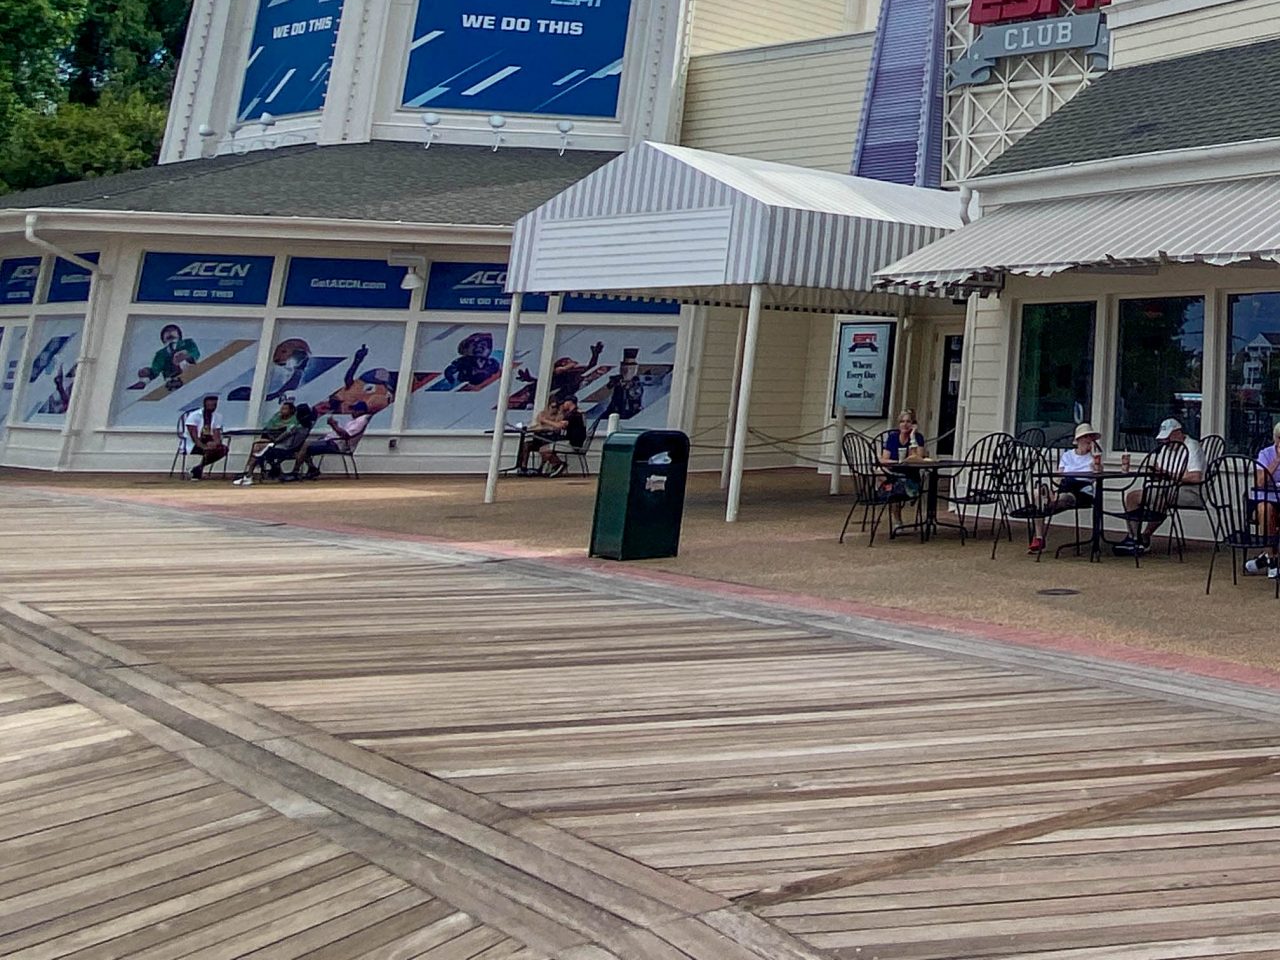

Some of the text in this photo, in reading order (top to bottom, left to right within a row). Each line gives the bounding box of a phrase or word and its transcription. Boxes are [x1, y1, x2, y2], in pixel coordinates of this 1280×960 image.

[272, 16, 333, 39] WE DO THIS
[462, 14, 583, 35] WE DO THIS
[1004, 21, 1073, 50] CLUB
[175, 261, 251, 277] ACCN
[852, 361, 873, 369] Where
[863, 371, 876, 381] Day
[863, 391, 876, 400] Day
